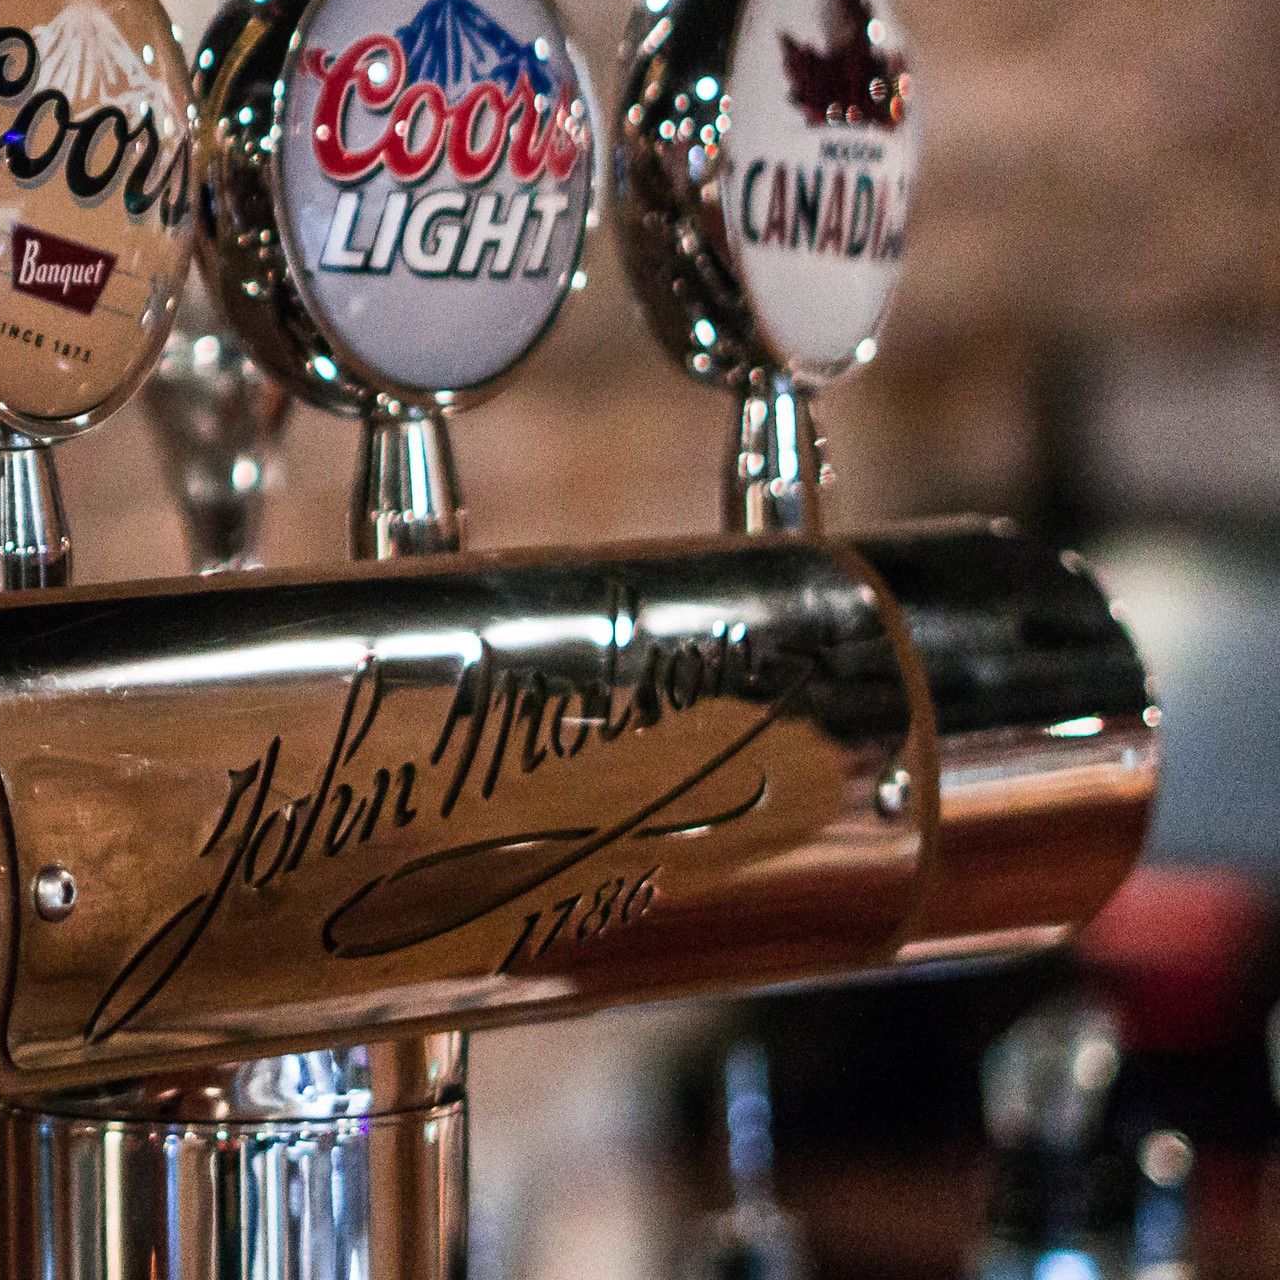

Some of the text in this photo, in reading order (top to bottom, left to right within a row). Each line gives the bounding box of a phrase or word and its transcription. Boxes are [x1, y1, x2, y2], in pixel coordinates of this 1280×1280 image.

[298, 33, 580, 183] Coors
[18, 238, 106, 296] Banquet
[319, 188, 570, 279] LIGHT
[82, 646, 417, 1046] John
[493, 863, 665, 978] 1786
